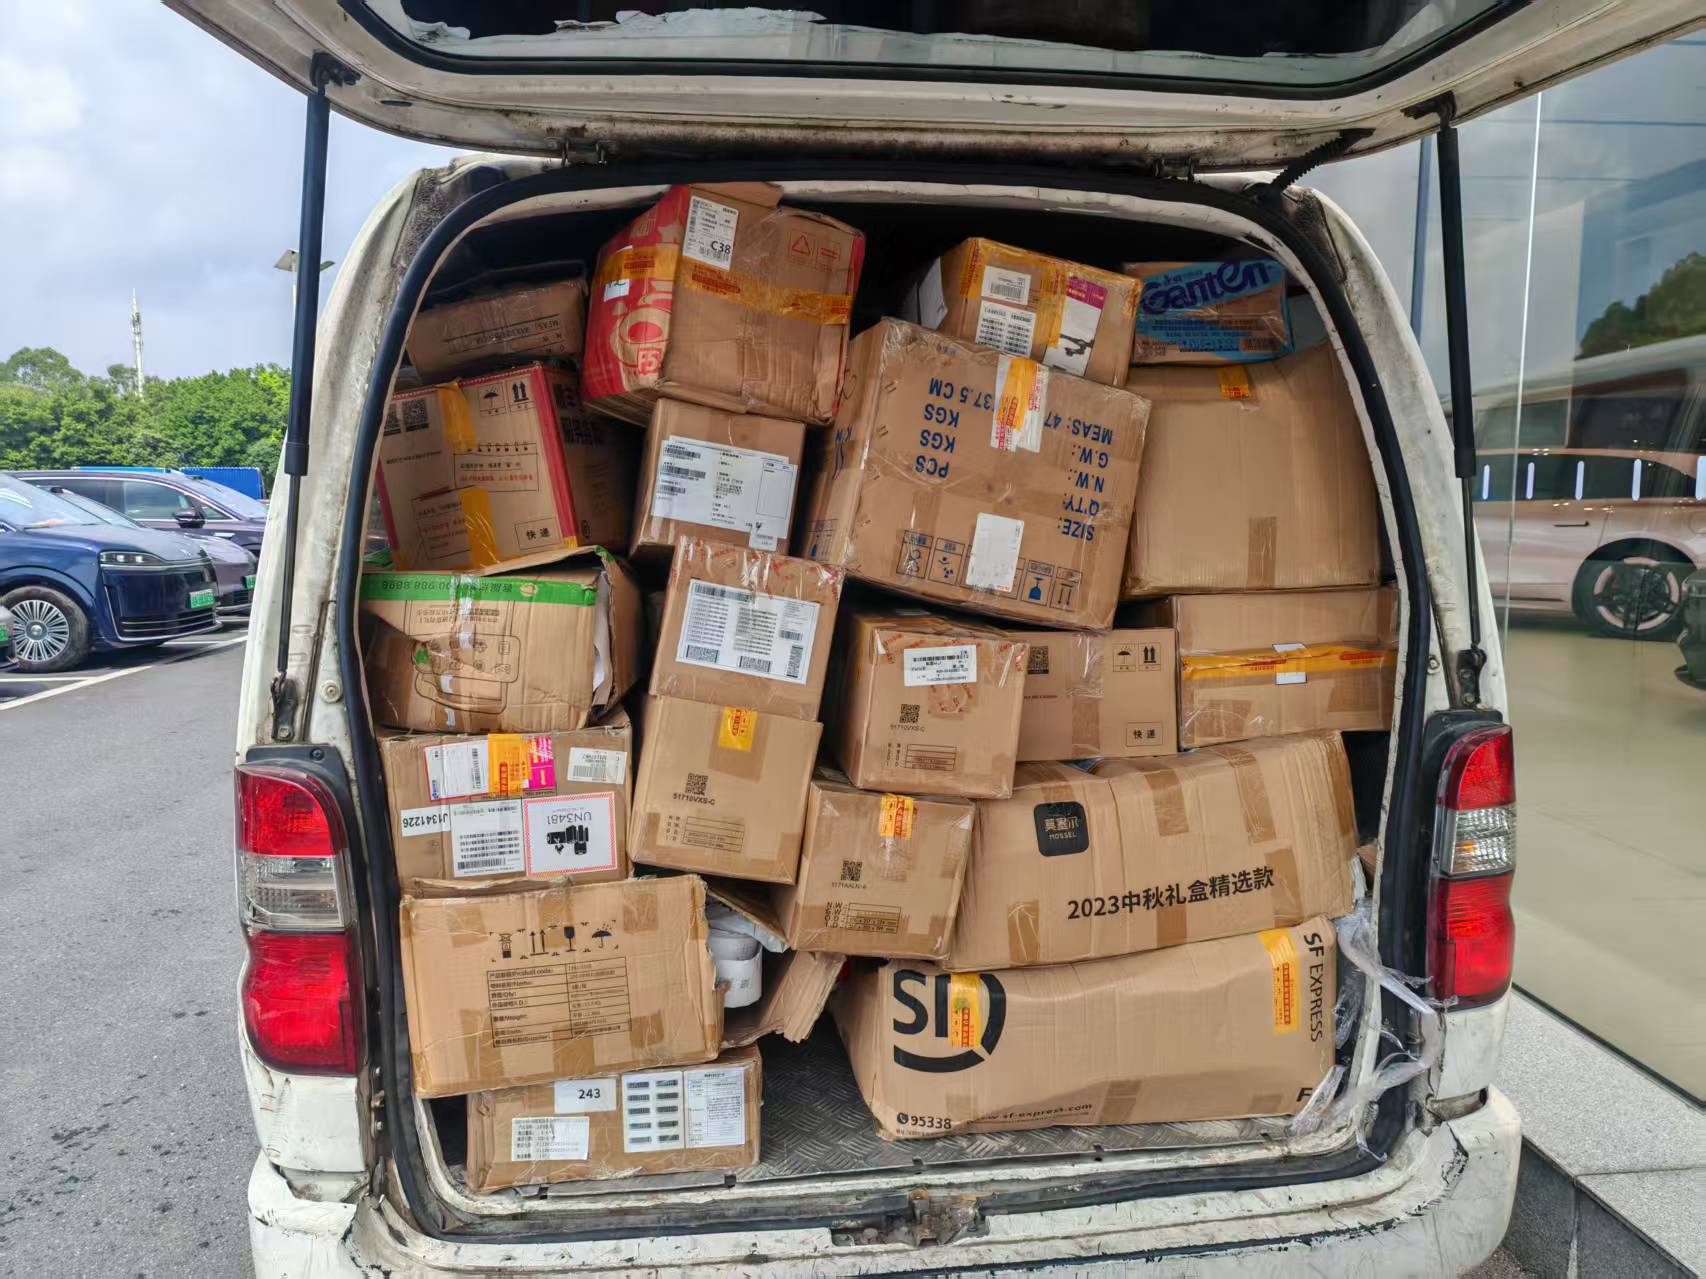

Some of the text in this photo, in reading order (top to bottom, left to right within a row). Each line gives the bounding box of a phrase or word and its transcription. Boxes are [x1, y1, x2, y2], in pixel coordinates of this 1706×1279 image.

[711, 241, 732, 254] C38
[924, 403, 960, 428] KGS
[929, 377, 1112, 446] MEAS: 47 37.5 CM
[919, 429, 955, 454] KGS
[915, 455, 950, 479] PCS
[1057, 516, 1096, 541] SIZE:
[402, 812, 449, 828] J1341226
[546, 811, 592, 825] UN3481
[1067, 865, 1275, 921] 2023中秋礼盒精选款
[1303, 932, 1324, 1042] SF EXPRESS
[578, 1089, 601, 1100] 243
[910, 1115, 952, 1129] 95338
